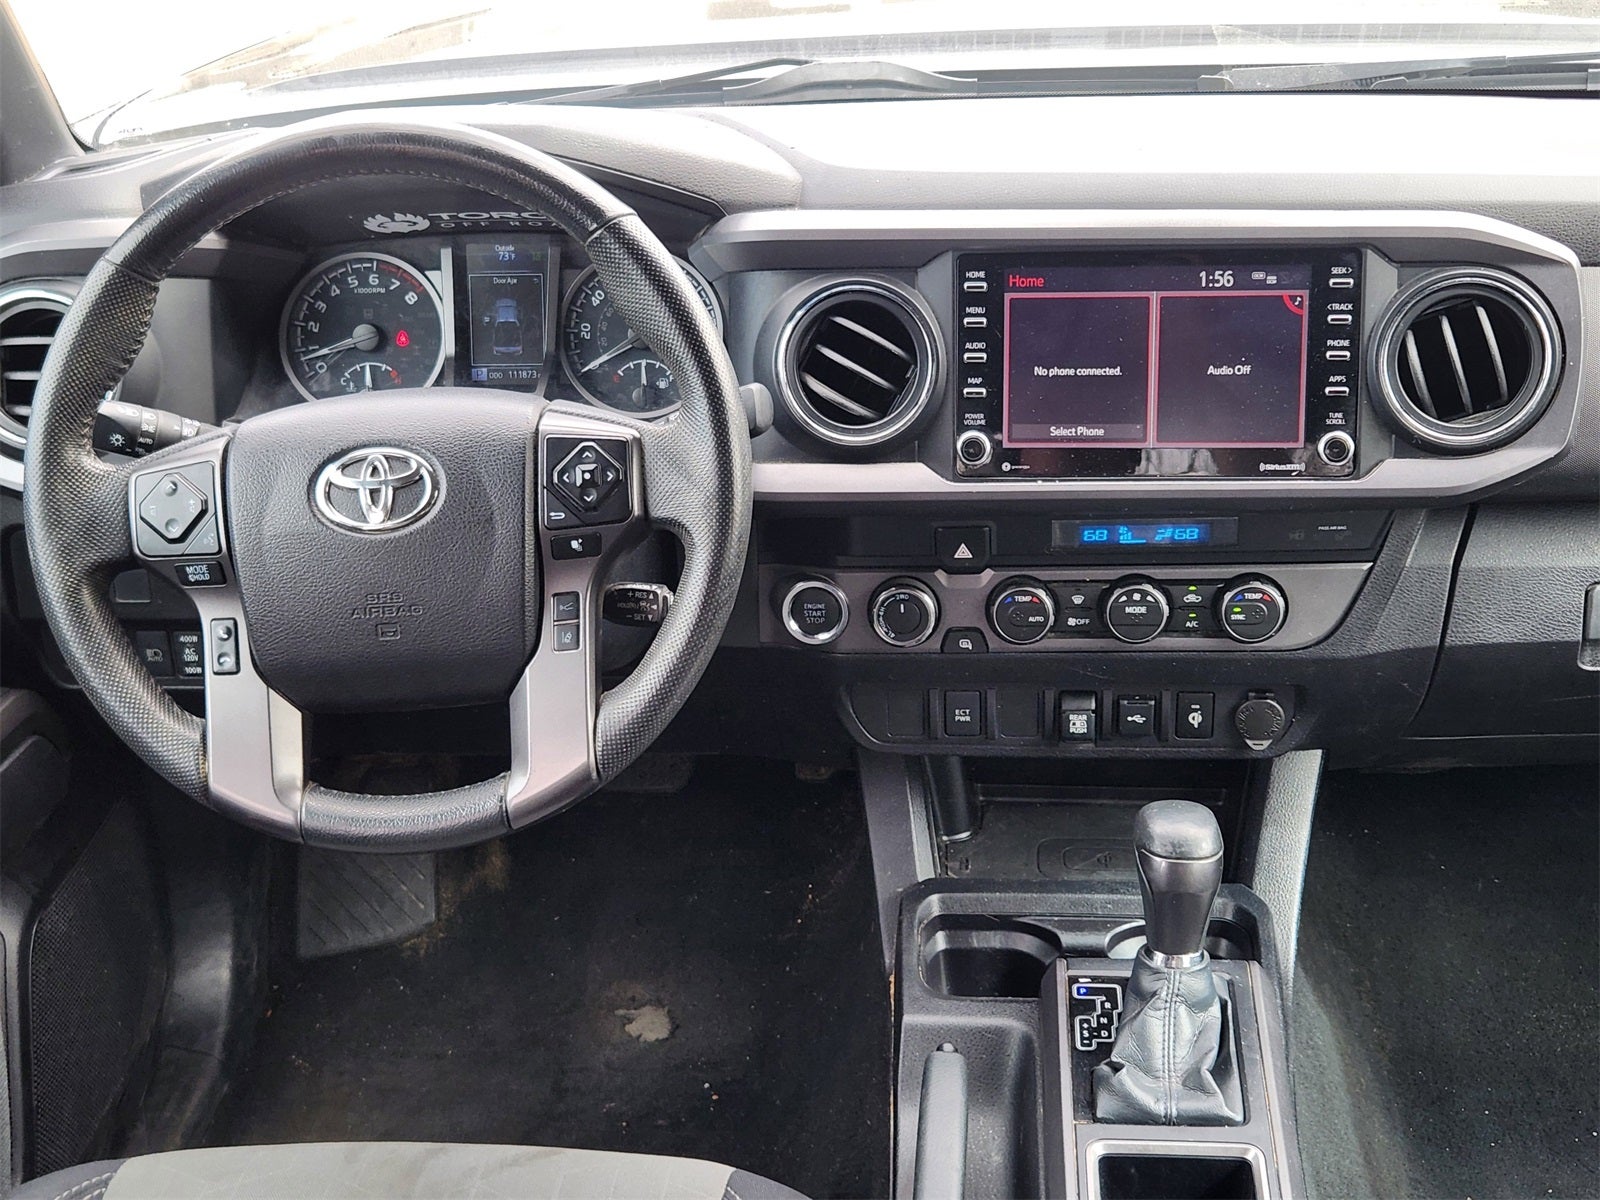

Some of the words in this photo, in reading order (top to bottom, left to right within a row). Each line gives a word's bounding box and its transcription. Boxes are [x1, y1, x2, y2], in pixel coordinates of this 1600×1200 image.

[428, 212, 546, 220] TORC
[348, 276, 359, 287] 5
[368, 274, 379, 285] 6
[493, 276, 506, 285] Door
[1009, 274, 1045, 287] Home
[1199, 270, 1234, 287] 1:56
[389, 279, 401, 291] 7
[330, 285, 341, 297] 4
[404, 291, 418, 305] 8
[591, 289, 605, 306] 40
[315, 301, 327, 314] 3
[308, 321, 320, 333] 2
[580, 323, 591, 340] 20
[509, 370, 537, 379] 111873
[1034, 366, 1048, 376] No
[1049, 366, 1075, 378] phone
[1076, 366, 1123, 376] connected.
[1207, 365, 1233, 375] Audio
[1234, 365, 1251, 375] Off
[967, 377, 983, 385] MAP
[1328, 375, 1346, 383] APPS
[1050, 426, 1076, 436] Select
[1077, 426, 1105, 436] Phone
[138, 436, 153, 445] AUTO
[1083, 529, 1108, 541] 68
[1174, 528, 1199, 540] 68
[186, 565, 209, 573] MODE
[366, 592, 404, 603] SRS
[1125, 606, 1147, 614] MODE
[1185, 620, 1199, 628] A/C
